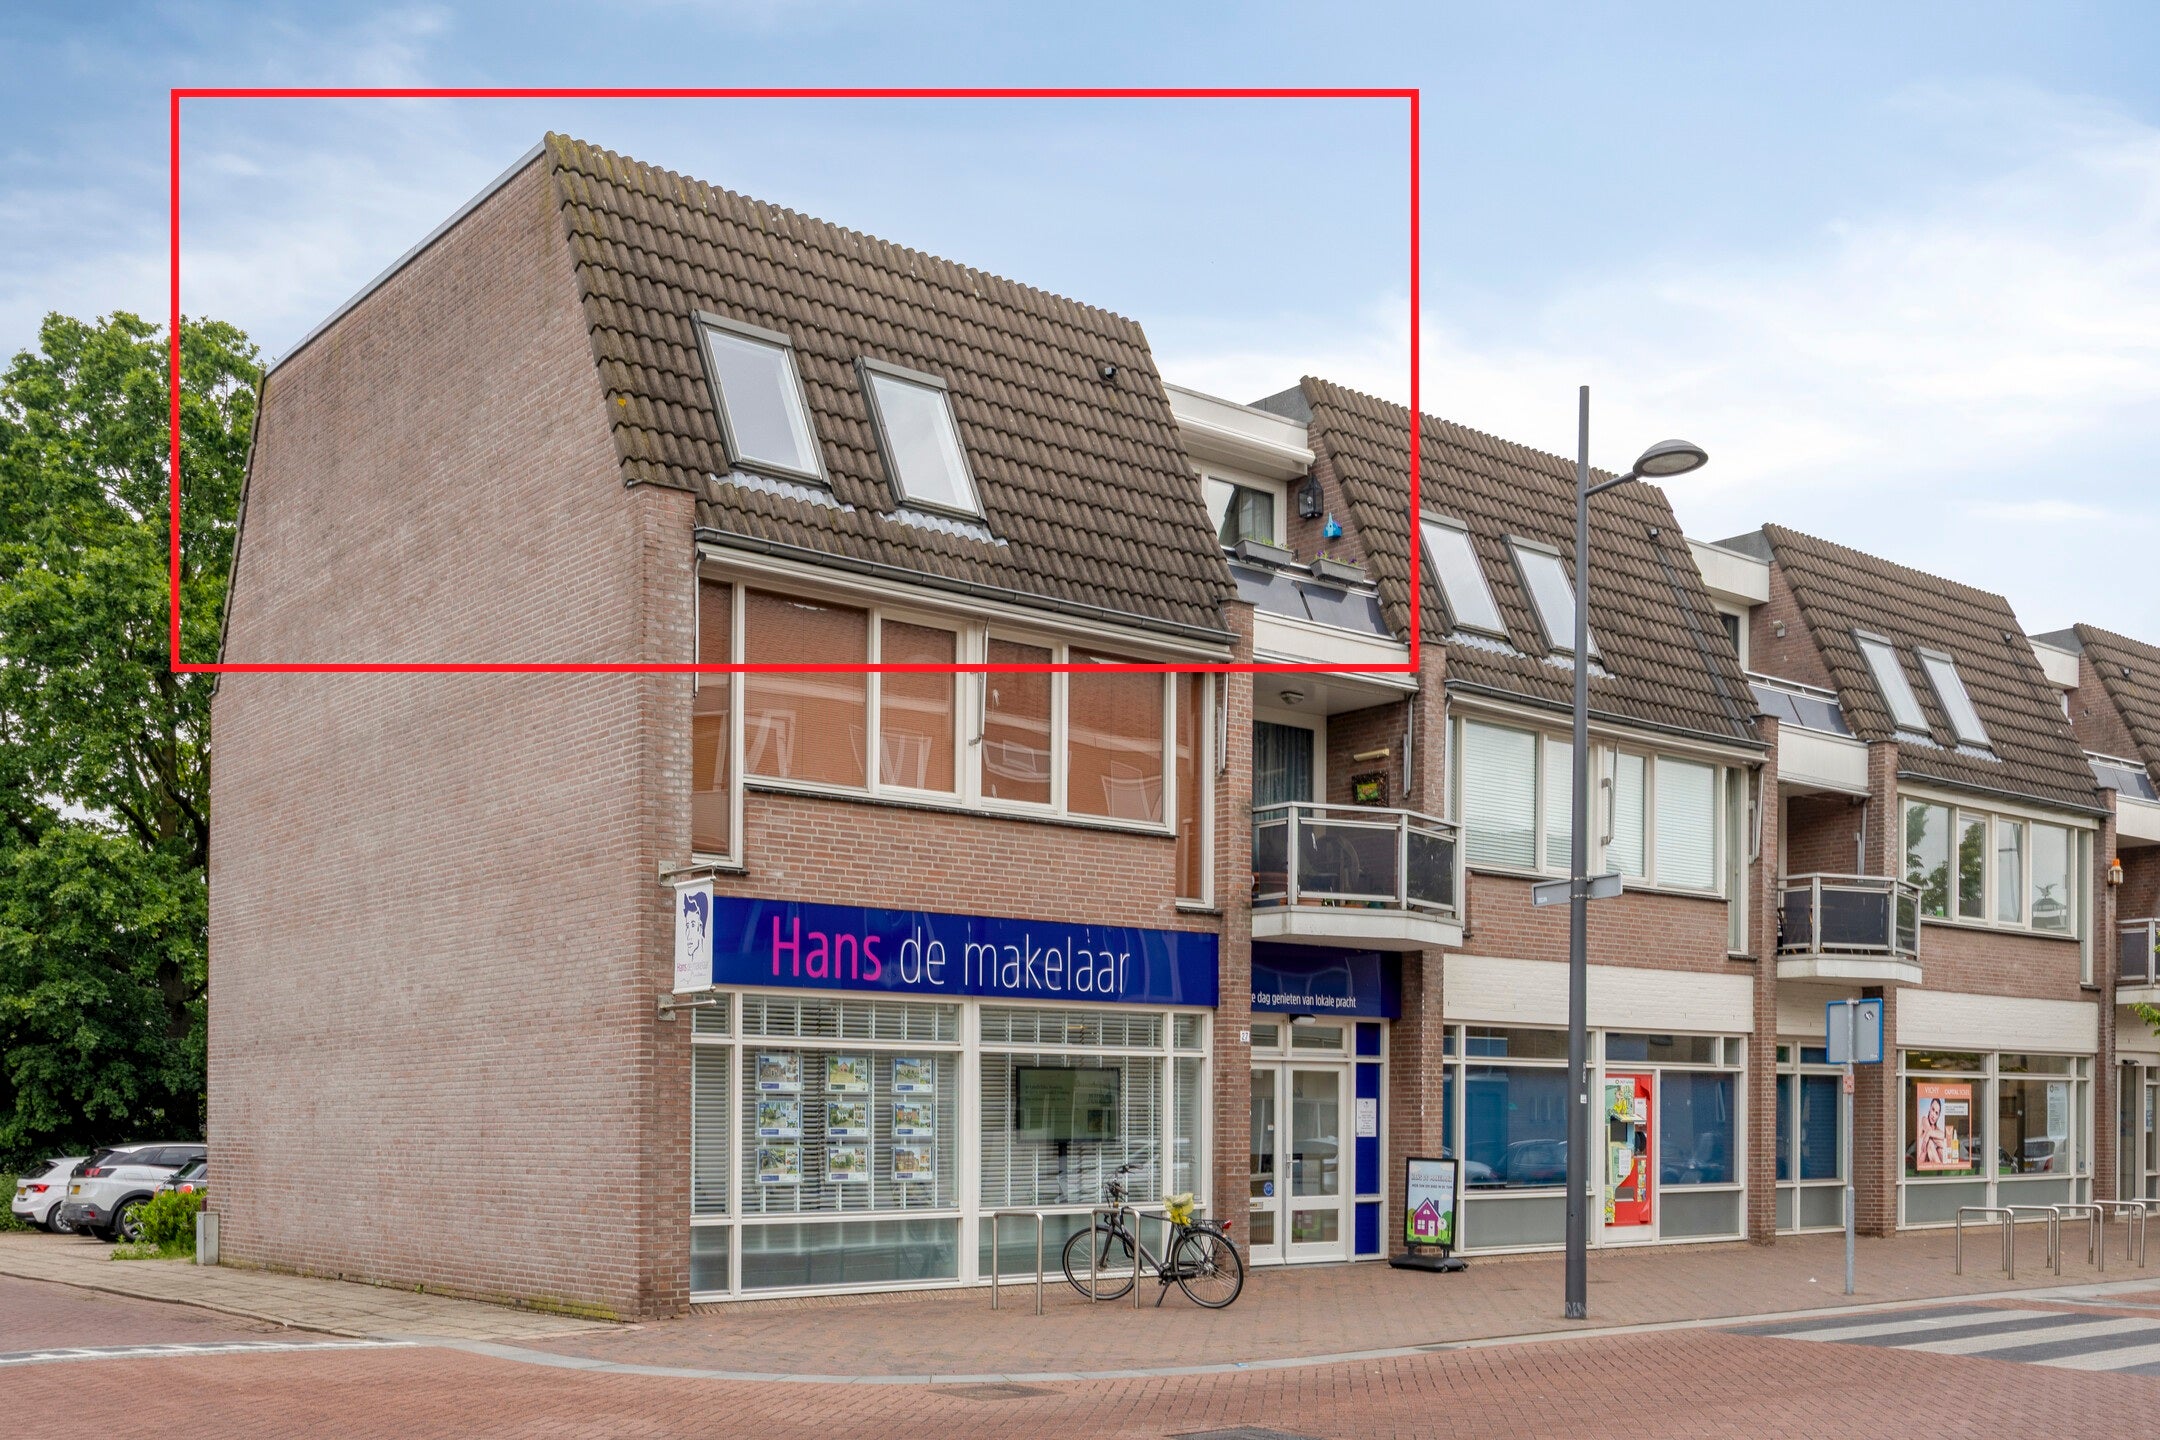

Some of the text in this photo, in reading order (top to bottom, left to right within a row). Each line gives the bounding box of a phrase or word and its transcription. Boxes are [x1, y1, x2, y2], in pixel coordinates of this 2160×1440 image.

[772, 915, 1131, 994] Hans de makelaar
[1257, 991, 1271, 1005] dag
[1271, 992, 1301, 1006] genieten
[1301, 996, 1315, 1006] van
[1315, 994, 1335, 1008] lokale
[1335, 996, 1357, 1008] pracht
[1241, 1032, 1249, 1040] 27
